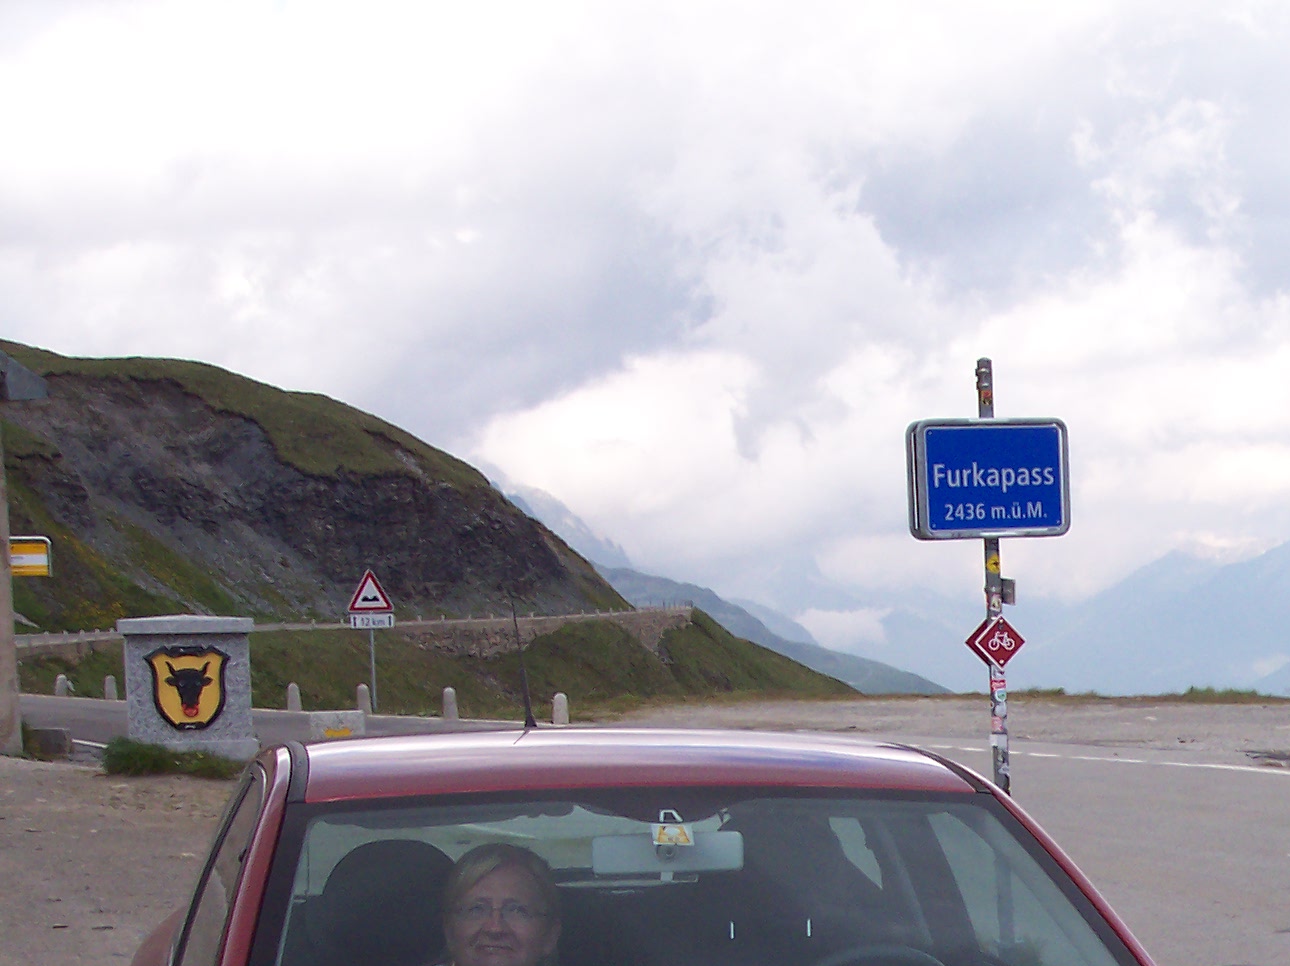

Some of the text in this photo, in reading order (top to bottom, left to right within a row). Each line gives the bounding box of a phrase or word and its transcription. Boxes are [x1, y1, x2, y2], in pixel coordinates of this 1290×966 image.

[933, 462, 1055, 493] Furkapass
[944, 501, 1048, 521] 2436 m.ü.M.
